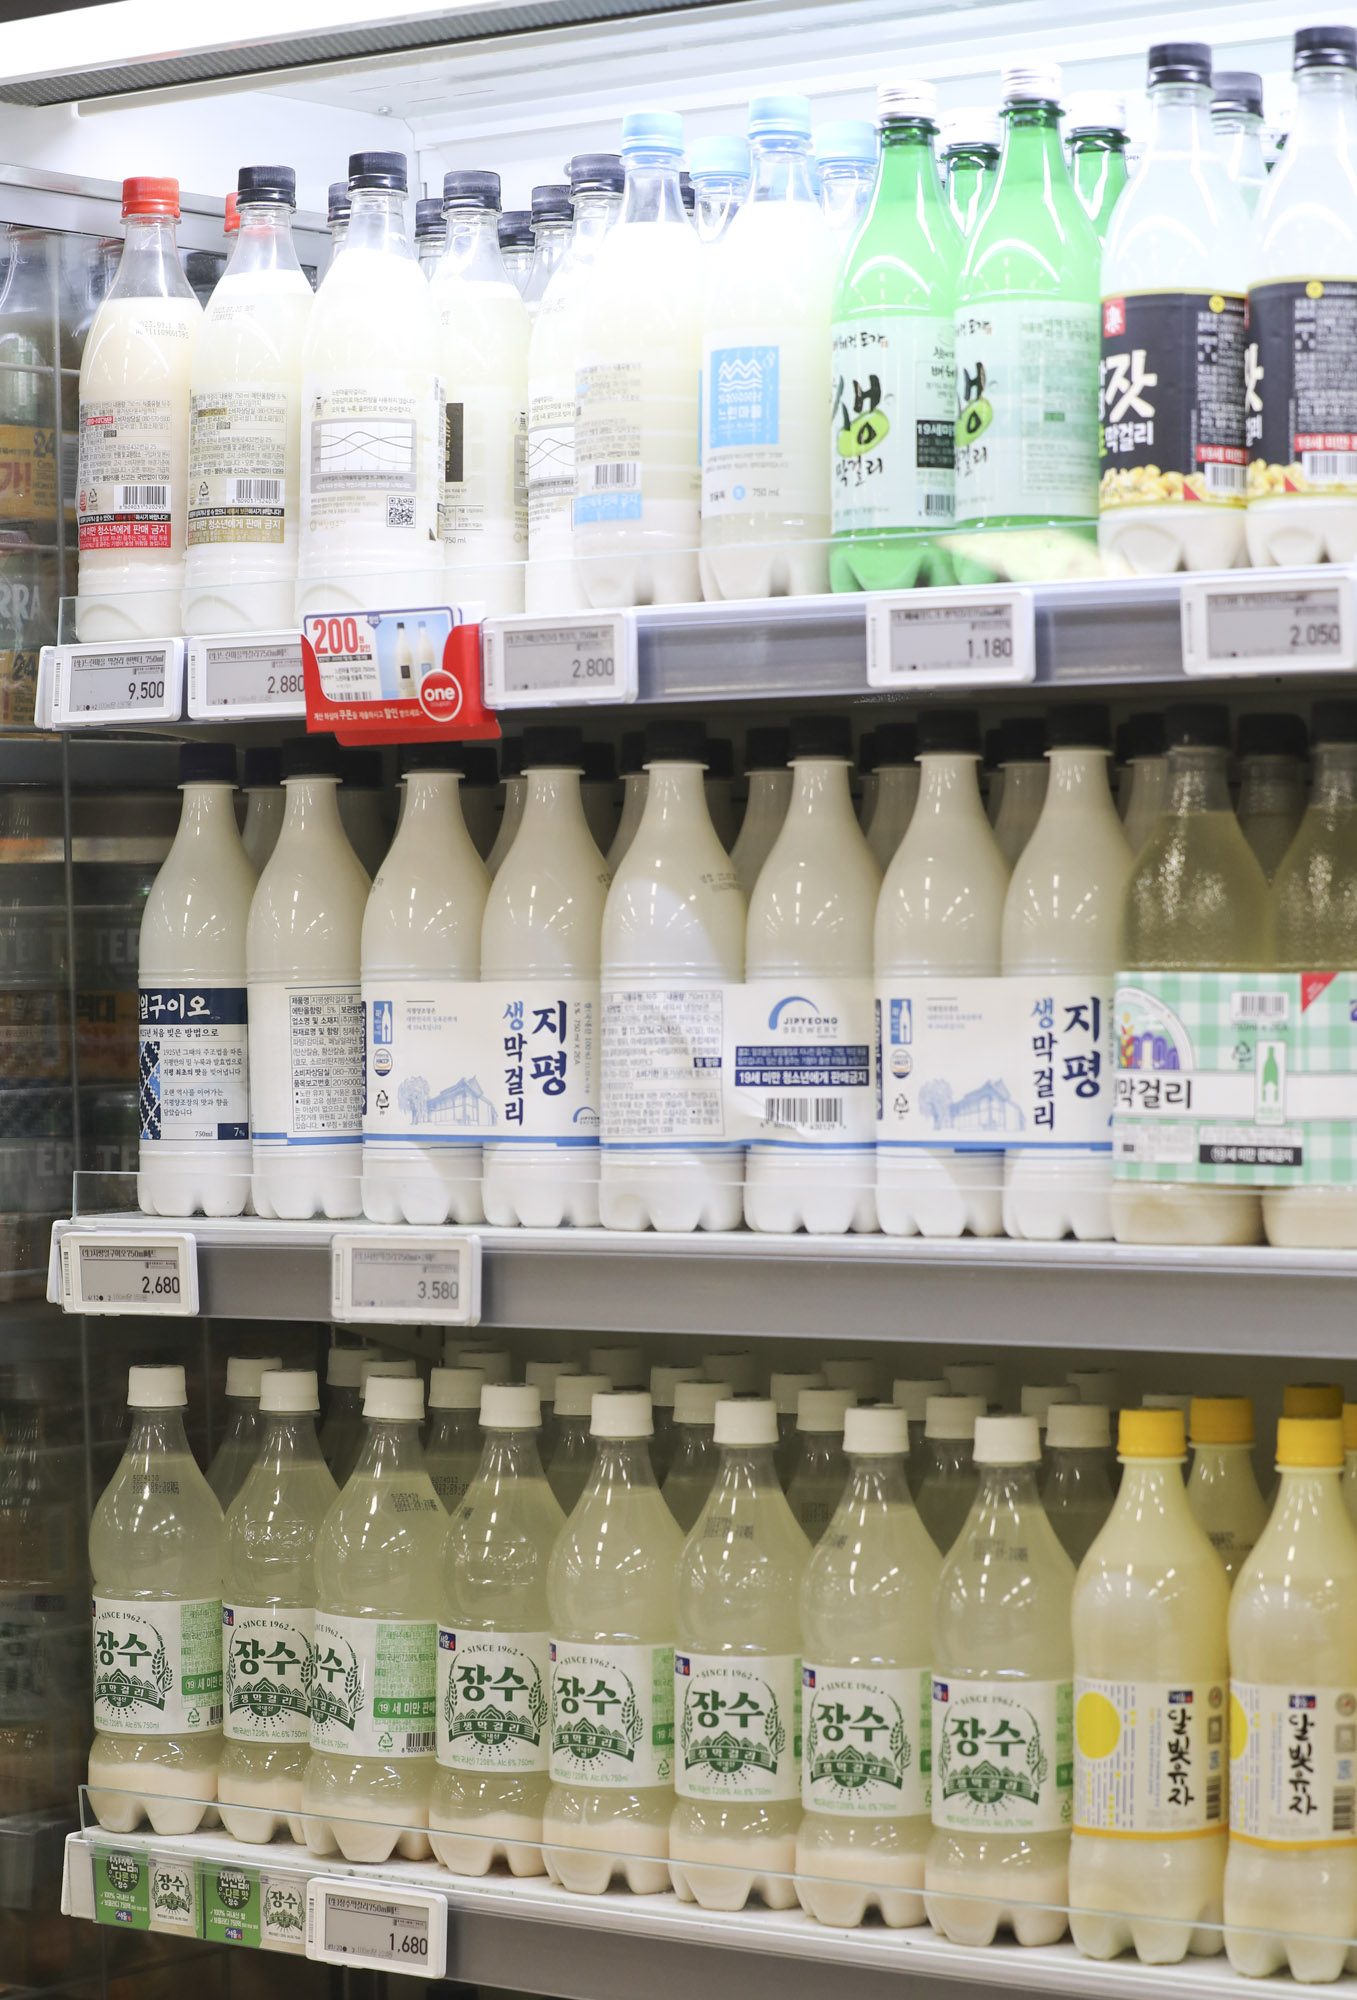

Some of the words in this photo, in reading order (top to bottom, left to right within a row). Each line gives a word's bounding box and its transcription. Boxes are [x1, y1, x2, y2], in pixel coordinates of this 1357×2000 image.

[718, 404, 762, 421] 느린마을
[1104, 421, 1154, 453] 막걸리
[836, 458, 883, 487] 막걸리
[98, 525, 130, 535] 청소년에게
[133, 525, 148, 534] 판매
[151, 525, 167, 534] 금지
[208, 520, 243, 529] 청소년에게
[246, 520, 261, 528] 판매
[264, 520, 280, 529] 금지
[313, 618, 359, 654] 200
[1289, 624, 1341, 647] 2,050
[968, 638, 1013, 659] 1,180
[572, 657, 614, 678] 2,800
[128, 680, 164, 700] 9,500
[267, 675, 304, 694] 2,880
[424, 688, 455, 701] one
[384, 708, 398, 719] 할인
[291, 996, 309, 1005] 제품명
[292, 1006, 322, 1015] 에탄올함량
[292, 1017, 310, 1025] 업소명
[312, 1017, 318, 1025] 및
[321, 1016, 338, 1024] 소재지
[784, 1017, 838, 1025] JIPYEONG
[152, 1029, 165, 1038] 처음
[167, 1028, 182, 1037] 빚은
[185, 1028, 219, 1038] 방법으로
[292, 1028, 316, 1036] 원재료명
[318, 1028, 325, 1036] 및
[326, 1028, 339, 1036] 함량
[163, 1048, 181, 1056] 1925년
[182, 1048, 201, 1056] 그때의
[530, 1000, 567, 1096] 지평
[1062, 996, 1101, 1098] 지평
[503, 1000, 527, 1126] 생막걸리
[1031, 997, 1058, 1131] 생막걸리
[175, 1068, 193, 1076] 최초의
[195, 1068, 208, 1076] 맛을
[210, 1068, 241, 1076] 빚어냅니다
[294, 1068, 330, 1076] 소비자상담실
[740, 1072, 760, 1084] 19세
[762, 1072, 780, 1084] 미만
[782, 1071, 829, 1084] 청소년에게
[831, 1071, 867, 1084] 판매금지
[294, 1079, 330, 1087] 품목보고번호
[195, 1130, 213, 1138] 750ml
[142, 1276, 180, 1295] 2,680
[417, 1281, 458, 1300] 3,580
[101, 1612, 120, 1620] SINCE
[123, 1612, 140, 1623] 1962
[242, 1620, 267, 1629] SINCE
[270, 1620, 290, 1631] 1962
[96, 1630, 152, 1668] 장수
[467, 1644, 494, 1654] SINCE
[498, 1645, 518, 1655] 1962
[234, 1639, 301, 1676] 장수
[564, 1656, 588, 1665] SINCE
[590, 1658, 610, 1668] 1962
[701, 1669, 729, 1678] SINCE
[732, 1669, 753, 1680] 1962
[197, 1678, 205, 1690] 세
[207, 1677, 218, 1688] 미만
[456, 1664, 529, 1702] 장수
[827, 1681, 854, 1691] SINCE
[856, 1682, 878, 1693] 1962
[240, 1693, 293, 1706] 생막걸리
[557, 1676, 622, 1716] 장수
[392, 1702, 401, 1715] 세
[404, 1702, 420, 1714] 미만
[691, 1689, 765, 1728] 장수
[142, 1721, 160, 1729] 750ml
[463, 1720, 519, 1733] 생막걸리
[817, 1702, 890, 1742] 장수
[252, 1728, 270, 1738] 7.208%
[292, 1729, 308, 1738] 750ml
[950, 1717, 1026, 1757] 장수
[115, 1872, 128, 1882] 다른
[131, 1874, 137, 1883] 맛
[158, 1874, 184, 1892] 장수
[226, 1889, 239, 1899] 다른
[242, 1891, 249, 1900] 맛
[270, 1891, 297, 1909] 장수
[227, 1910, 239, 1918] 국내산
[389, 1933, 428, 1956] 1,680
